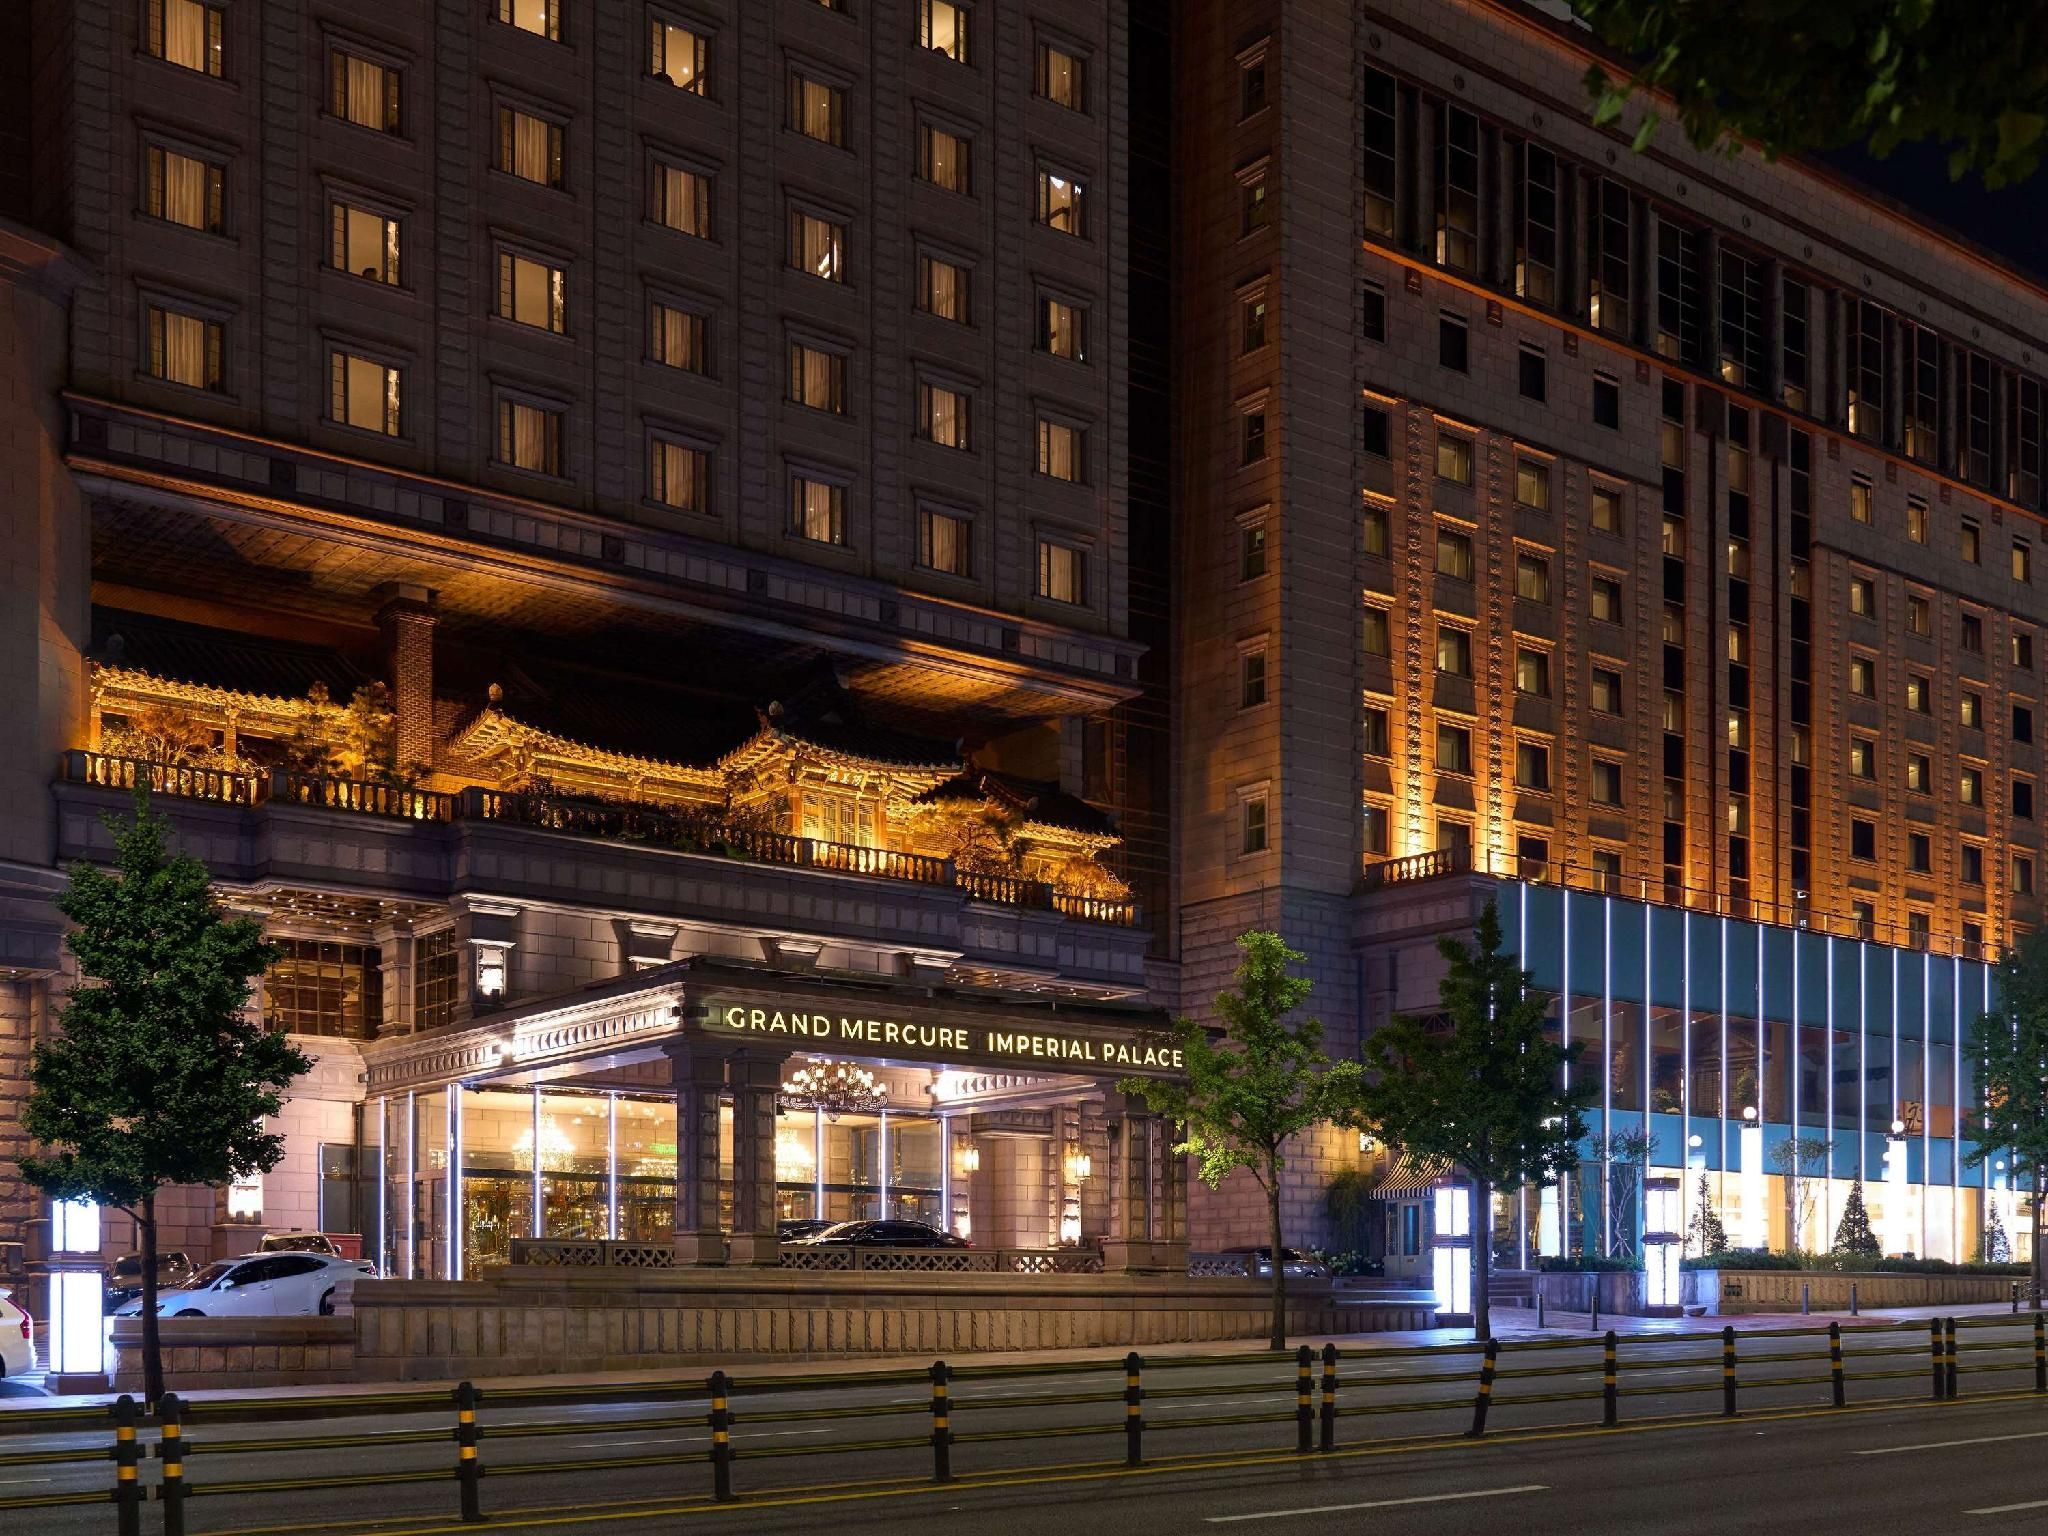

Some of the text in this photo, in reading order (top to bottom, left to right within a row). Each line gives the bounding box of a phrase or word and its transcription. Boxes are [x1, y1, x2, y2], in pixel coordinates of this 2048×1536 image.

[726, 1007, 1183, 1068] GRAND MERCURE IMPERIAL PALACE
